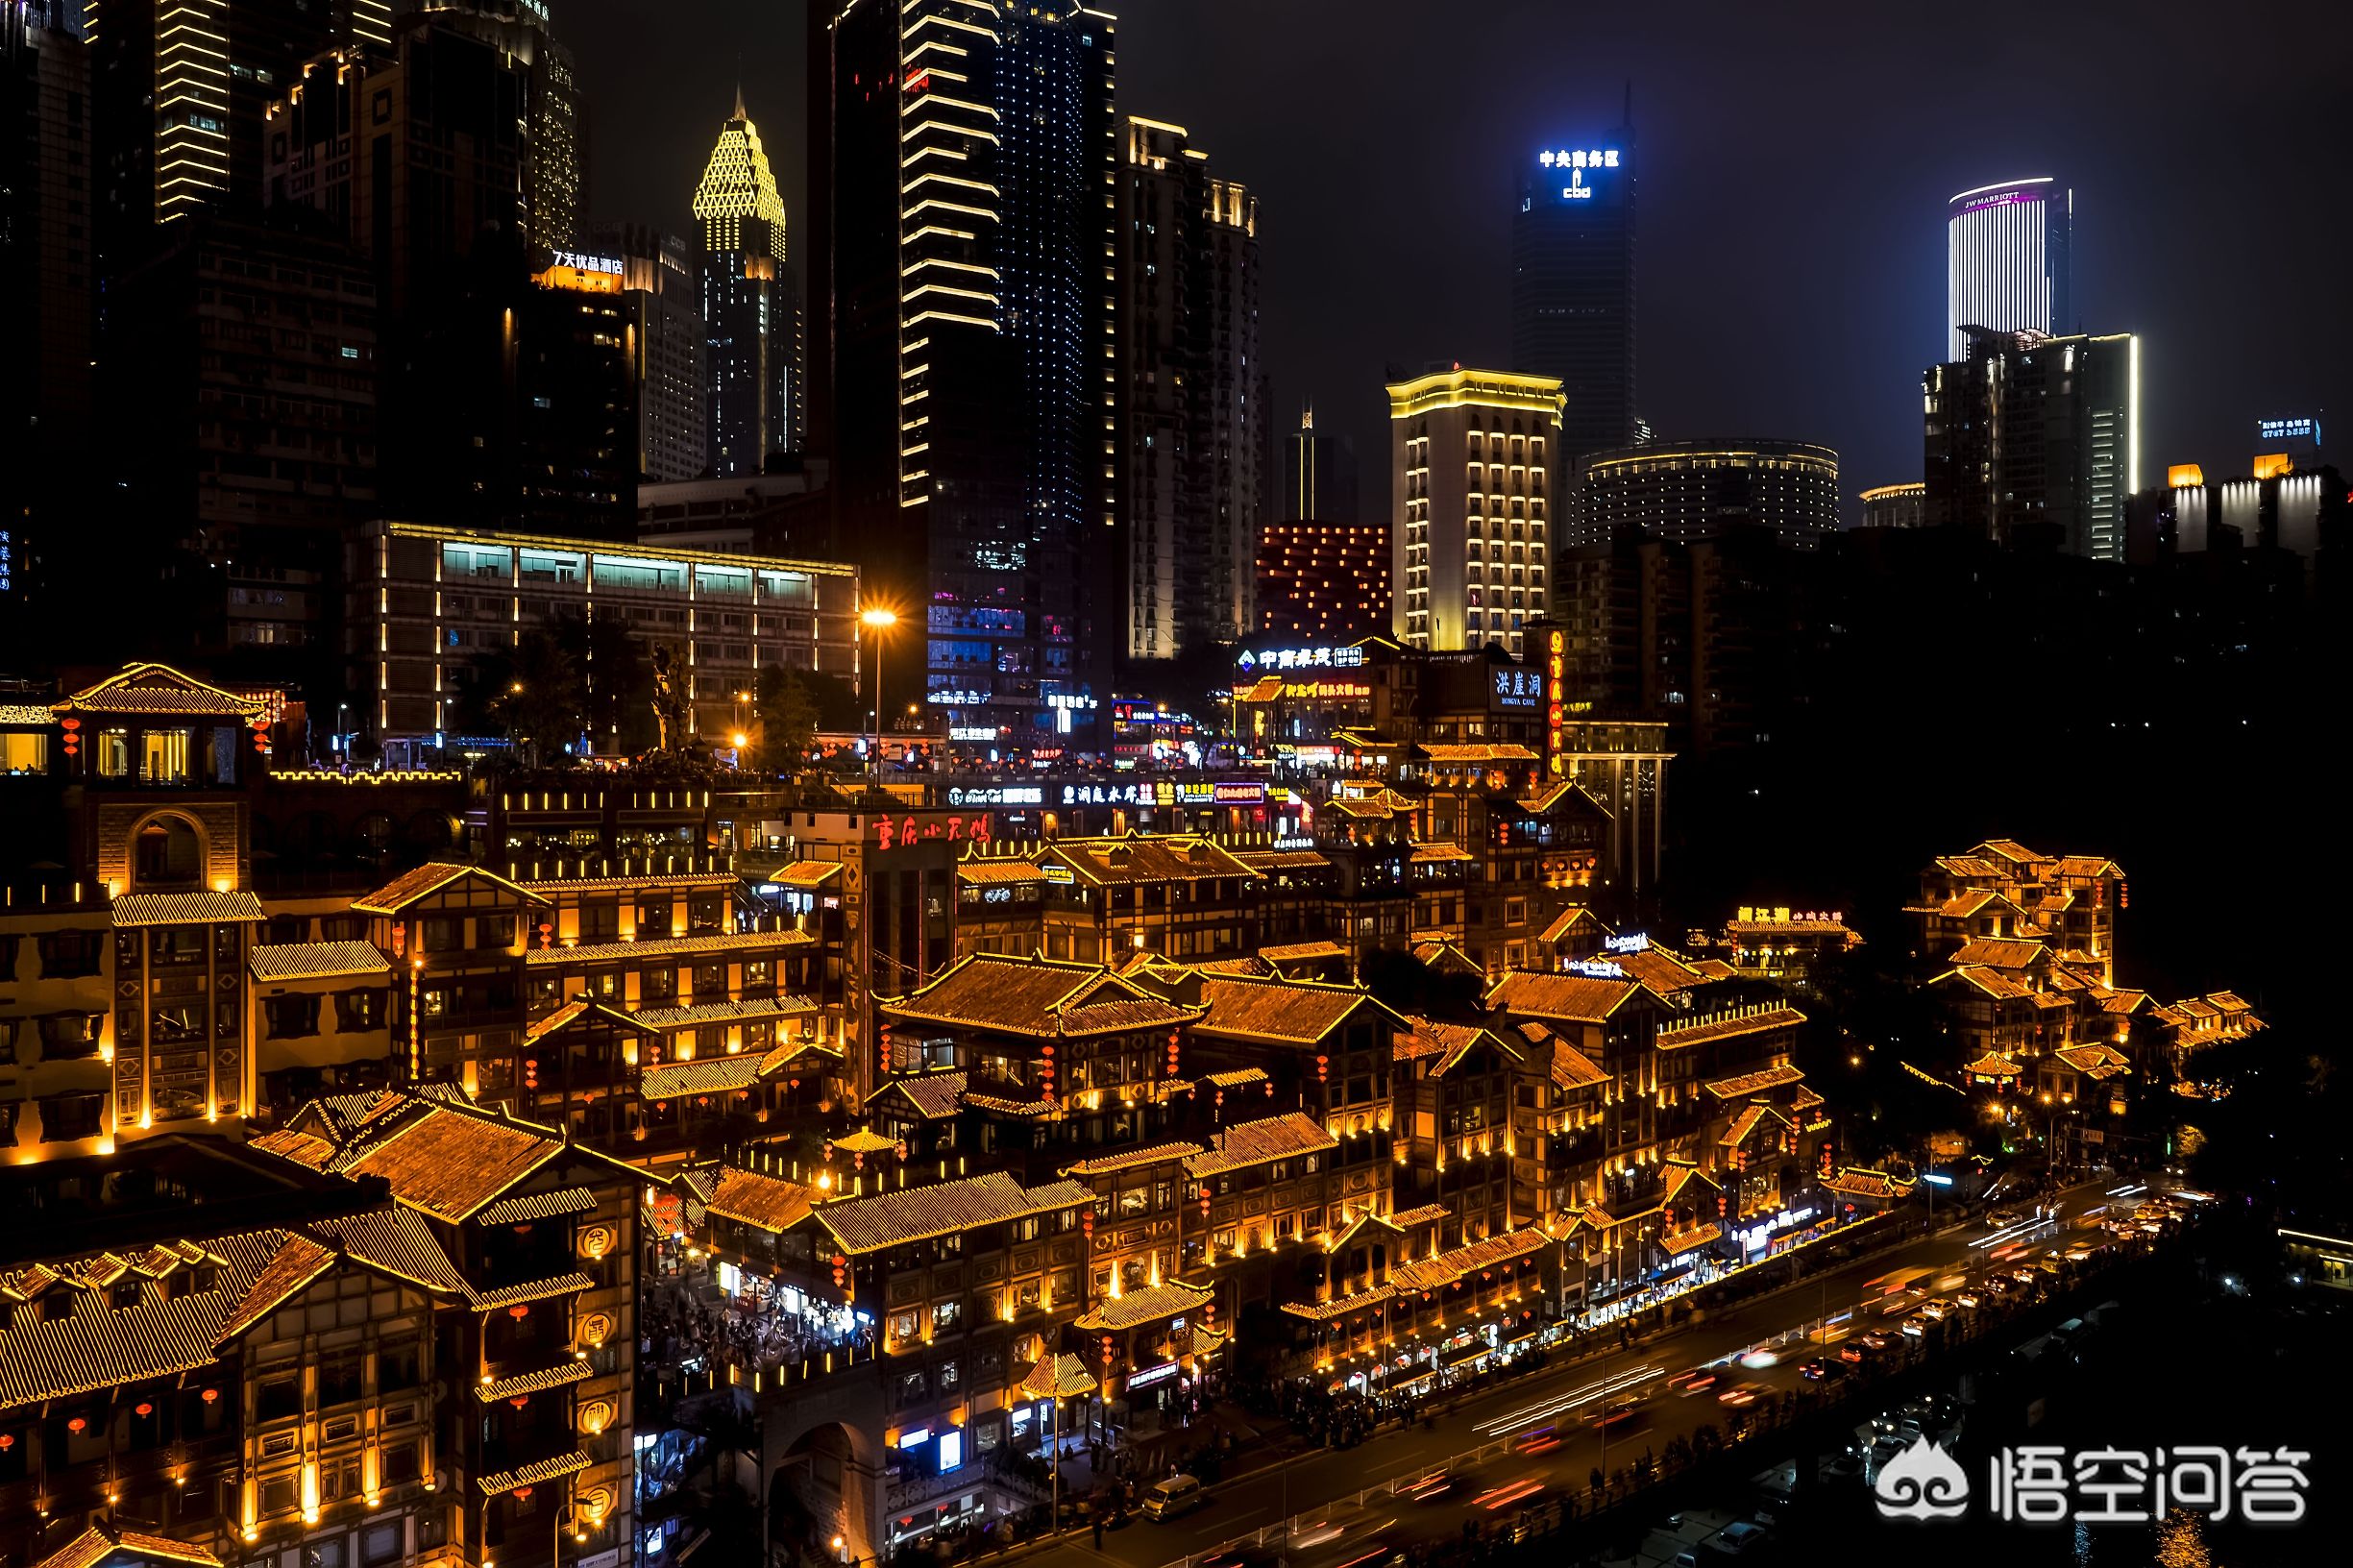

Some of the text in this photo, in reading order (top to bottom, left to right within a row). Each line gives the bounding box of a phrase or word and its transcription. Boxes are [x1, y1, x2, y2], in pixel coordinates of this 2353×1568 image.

[1539, 150, 1619, 168] 中央商务区
[1977, 191, 2019, 205] MARRIOTT
[552, 251, 624, 276] 7天优品酒店
[1495, 671, 1541, 698] 洪崖洞
[871, 814, 992, 850] 重庆小天鹅
